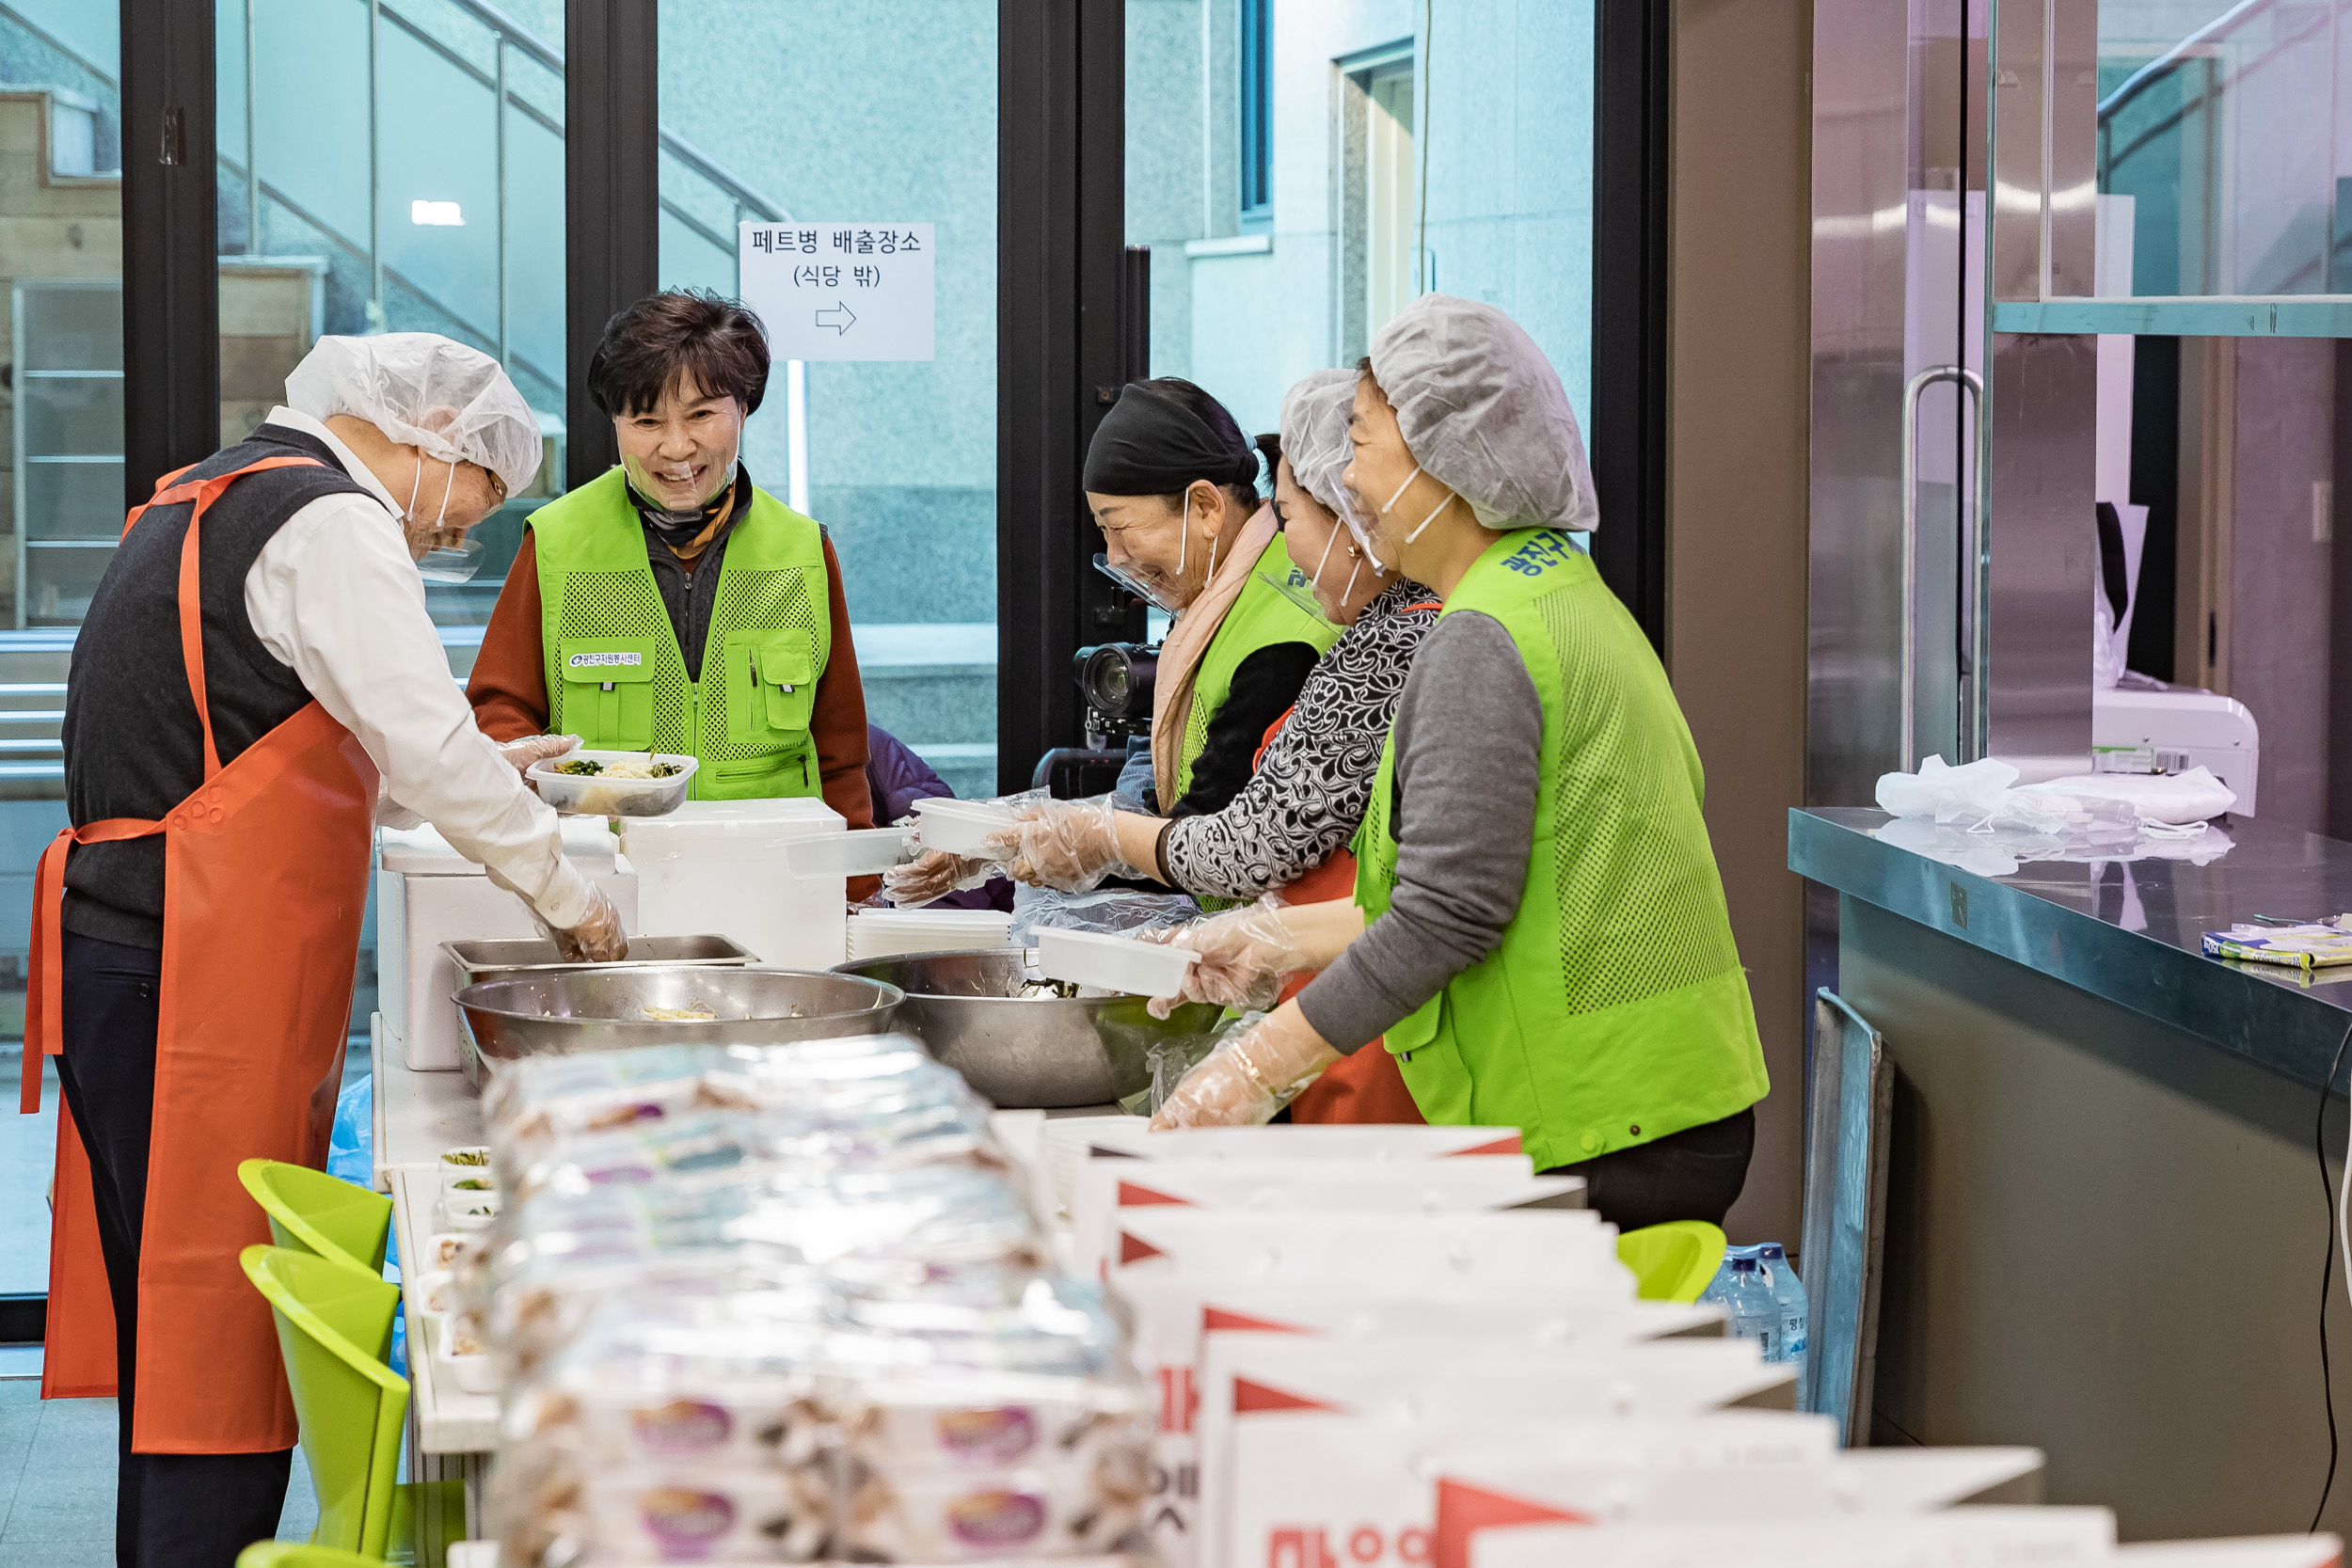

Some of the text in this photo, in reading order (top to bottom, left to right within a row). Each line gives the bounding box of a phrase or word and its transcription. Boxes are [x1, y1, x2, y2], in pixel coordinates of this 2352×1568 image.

[753, 230, 921, 254] 페트병 배출장소
[793, 264, 881, 287] (식당 밖)
[583, 654, 640, 665] 광진구자원봉사센터
